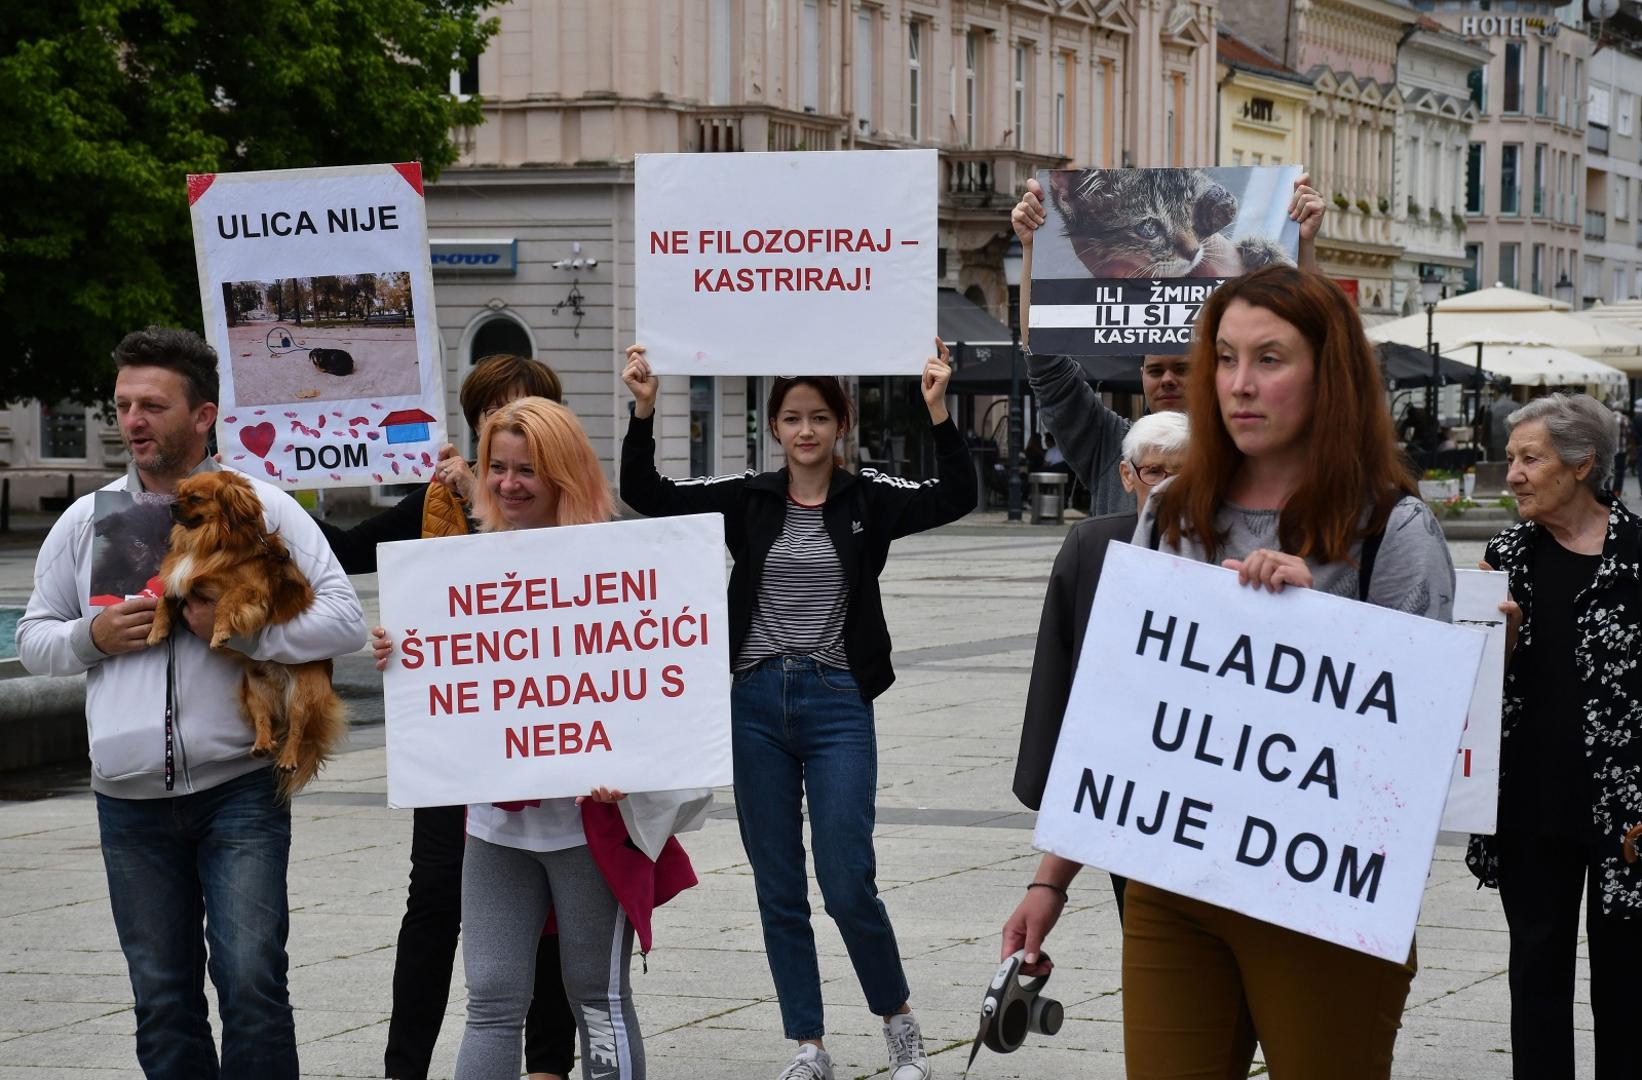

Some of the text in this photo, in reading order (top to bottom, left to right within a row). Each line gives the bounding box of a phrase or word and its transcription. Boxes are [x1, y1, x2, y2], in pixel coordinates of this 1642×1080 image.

[1462, 16, 1528, 36] HOTEL
[217, 205, 399, 240] ULICA NIJE
[650, 230, 688, 255] NE
[699, 228, 891, 254] FILOZOFIRAJ
[694, 267, 872, 293] KASTRIRAJ!
[1096, 286, 1123, 303] ILI
[1095, 305, 1130, 326] ILI
[1144, 305, 1170, 326] SI
[294, 442, 369, 471] DOM
[448, 568, 657, 617] NEŽELJENI
[401, 606, 709, 670] ŠTENCI I MAČIĆI
[1135, 609, 1398, 724] HLADNA
[429, 664, 685, 716] NE PADAJU S
[505, 720, 612, 759] NEBA
[1151, 701, 1339, 800] ULICA
[1073, 767, 1386, 904] NIJE DOM
[580, 1003, 618, 1068] NIKE
